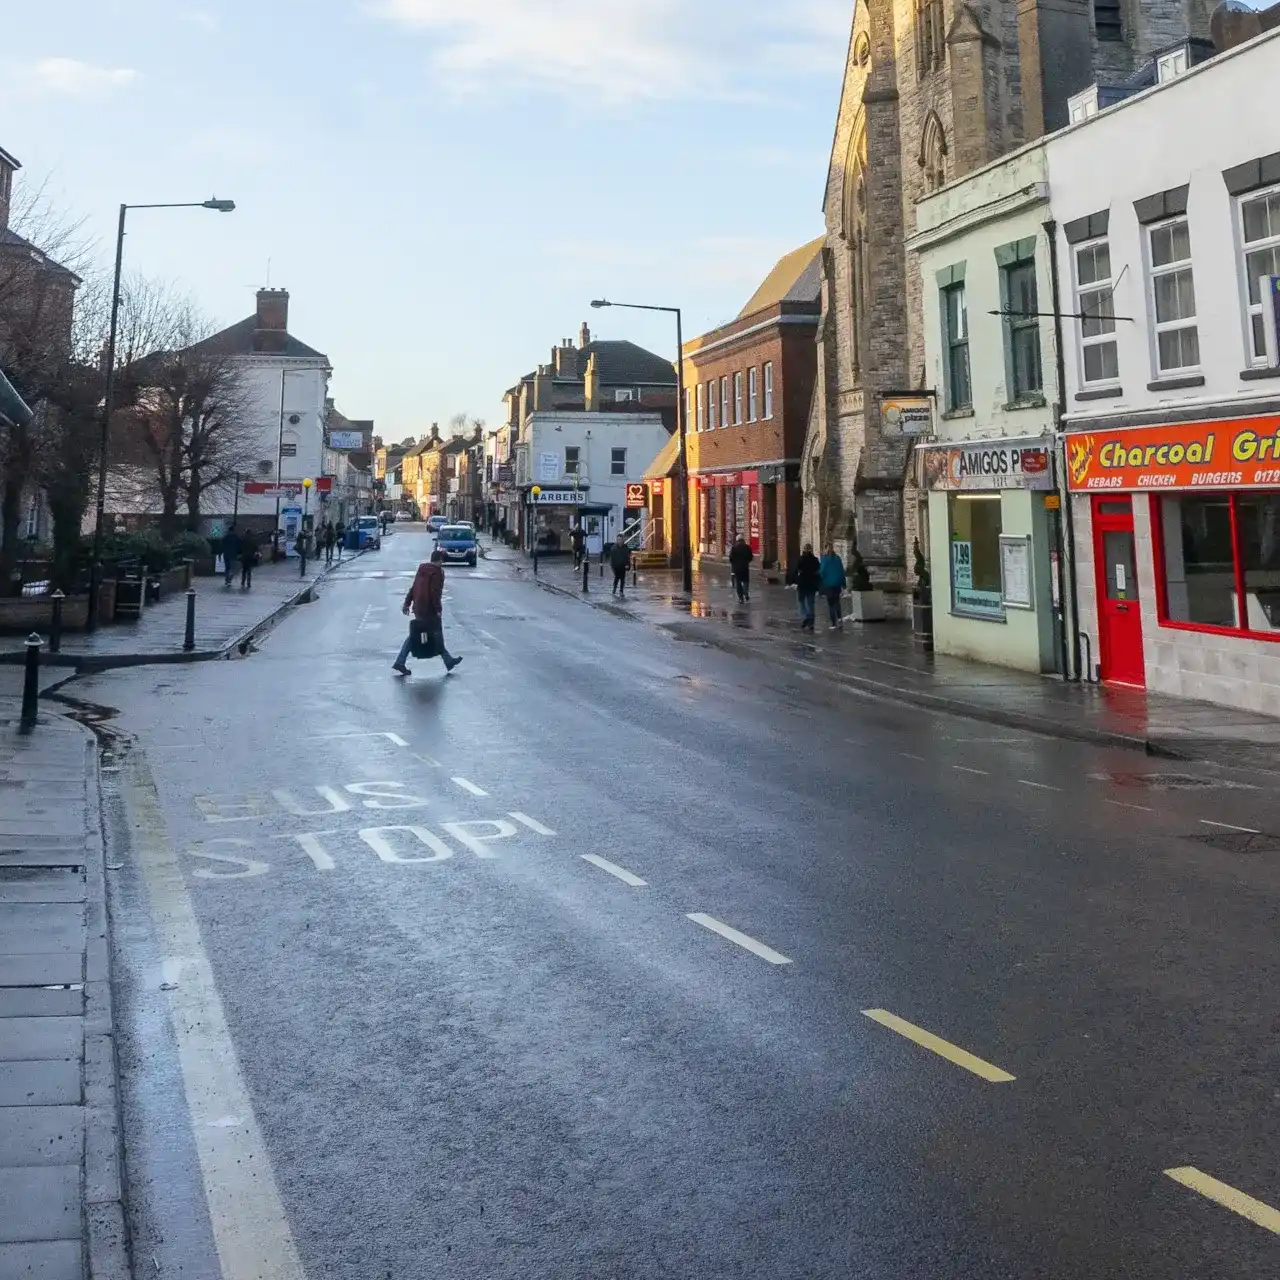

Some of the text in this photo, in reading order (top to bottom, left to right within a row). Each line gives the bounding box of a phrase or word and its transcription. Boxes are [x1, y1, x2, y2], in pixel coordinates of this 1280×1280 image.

[904, 414, 930, 423] pizza
[959, 448, 1009, 475] AMIGOS
[1098, 432, 1216, 468] Charcoal
[1087, 476, 1123, 488] KEBABS
[1137, 474, 1177, 486] CHICKEN
[1191, 471, 1242, 485] BURGERS
[193, 779, 427, 822] BUS
[185, 810, 518, 879] STOP
